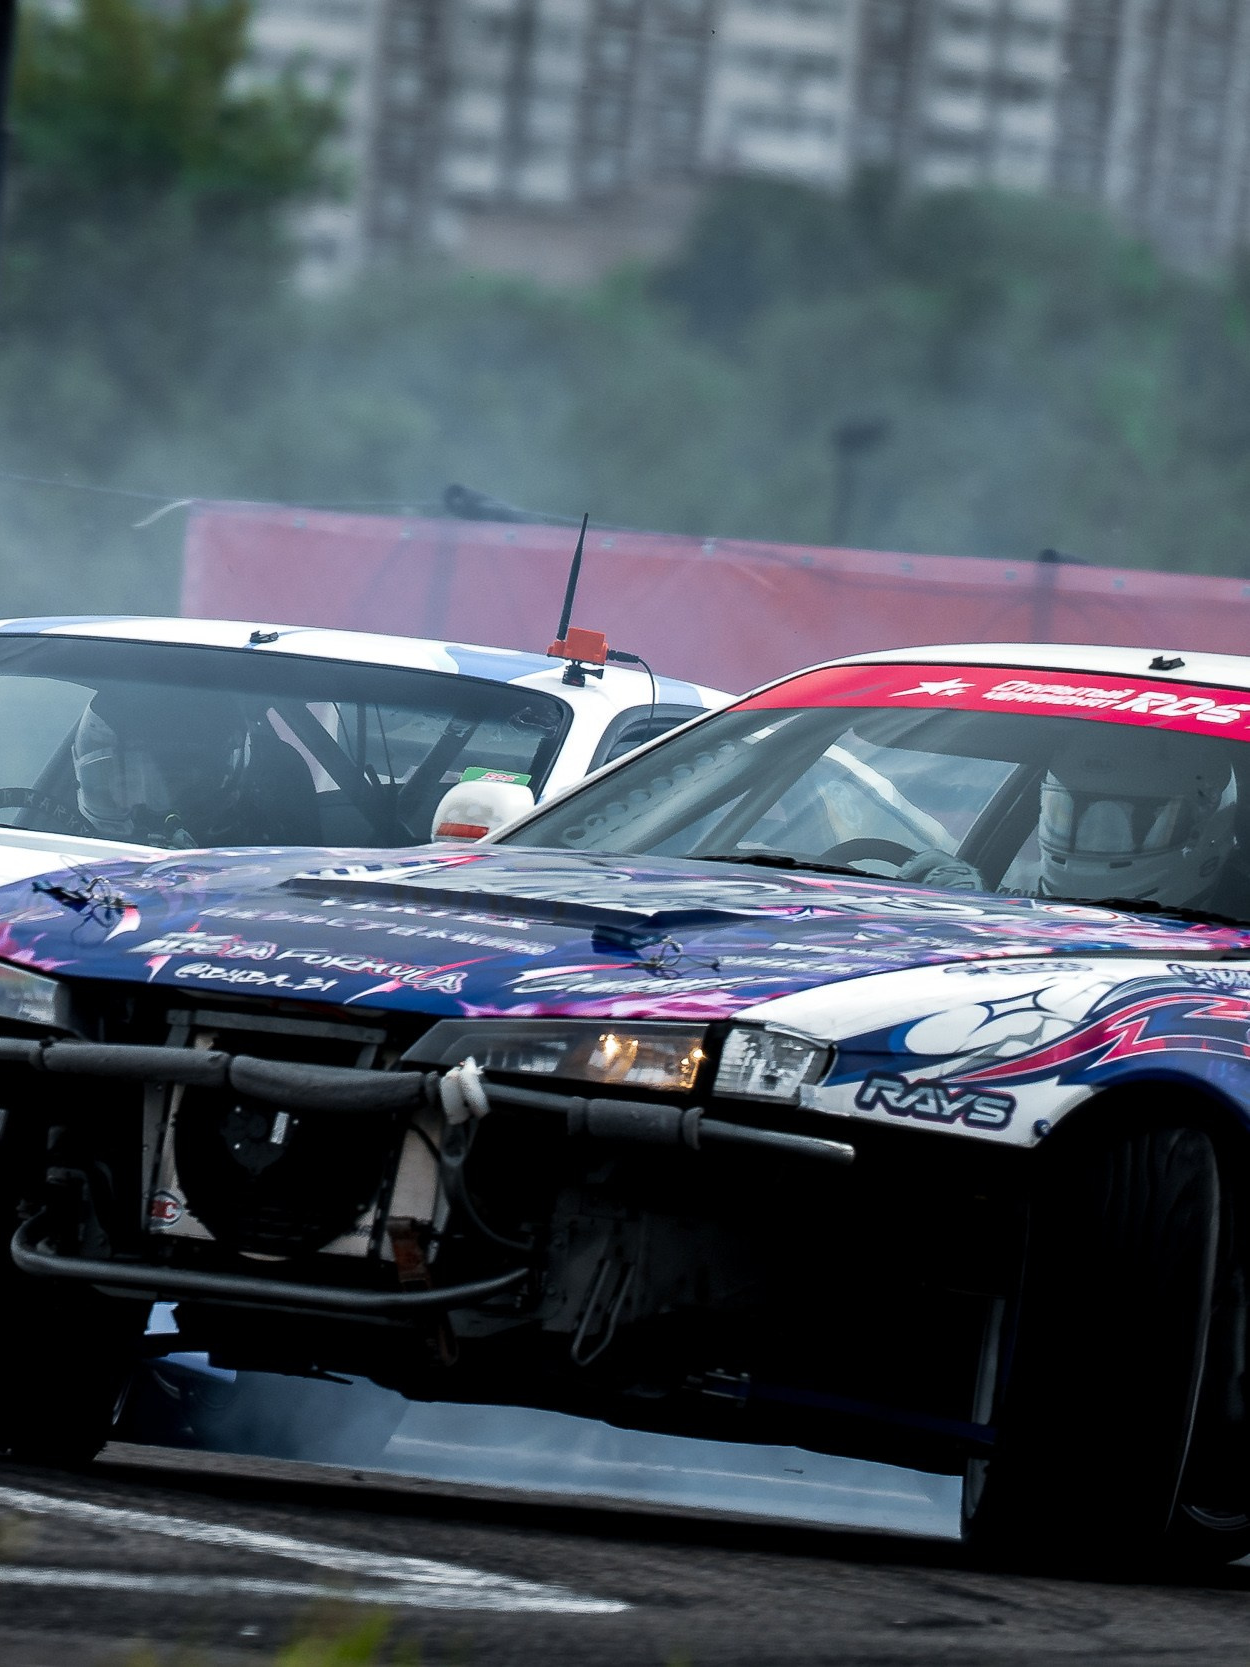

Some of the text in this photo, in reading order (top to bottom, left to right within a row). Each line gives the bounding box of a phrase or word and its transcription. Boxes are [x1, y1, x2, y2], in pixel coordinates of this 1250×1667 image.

[1112, 691, 1249, 724] RDS
[274, 947, 468, 994] FORMULA
[856, 1073, 1014, 1128] RAYS
